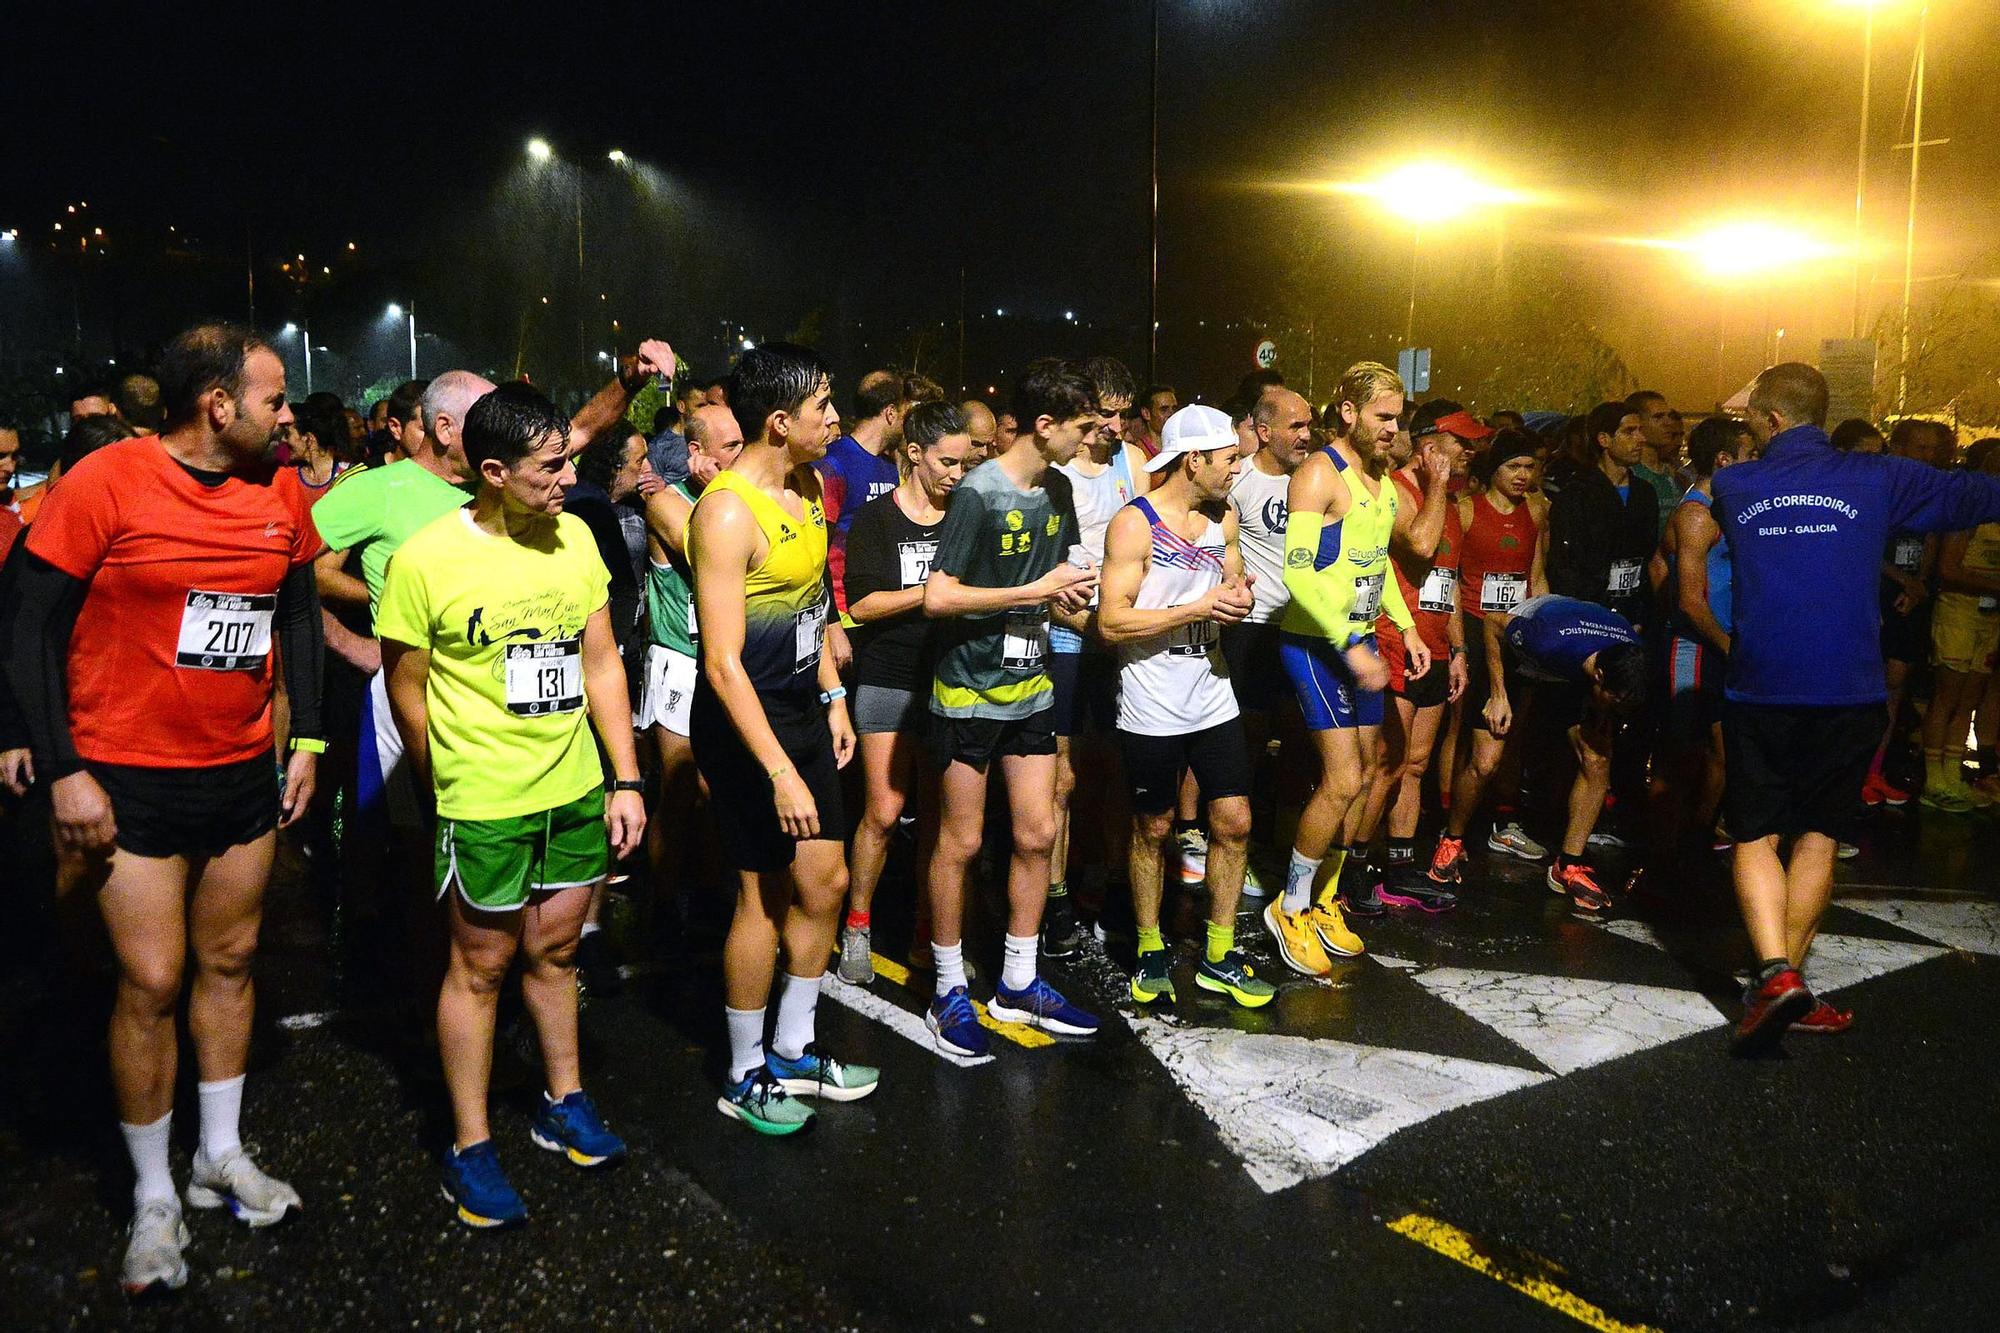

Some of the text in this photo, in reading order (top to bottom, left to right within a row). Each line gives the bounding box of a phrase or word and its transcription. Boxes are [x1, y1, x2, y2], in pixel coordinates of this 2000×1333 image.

[1258, 348, 1276, 361] 40
[1737, 495, 1858, 524] CLUBE CORREDOIRAS
[1759, 527, 1787, 536] BUEU
[1795, 524, 1838, 534] GALICIA
[1496, 586, 1517, 602] 162
[204, 620, 255, 654] 207
[537, 667, 565, 698] 131
